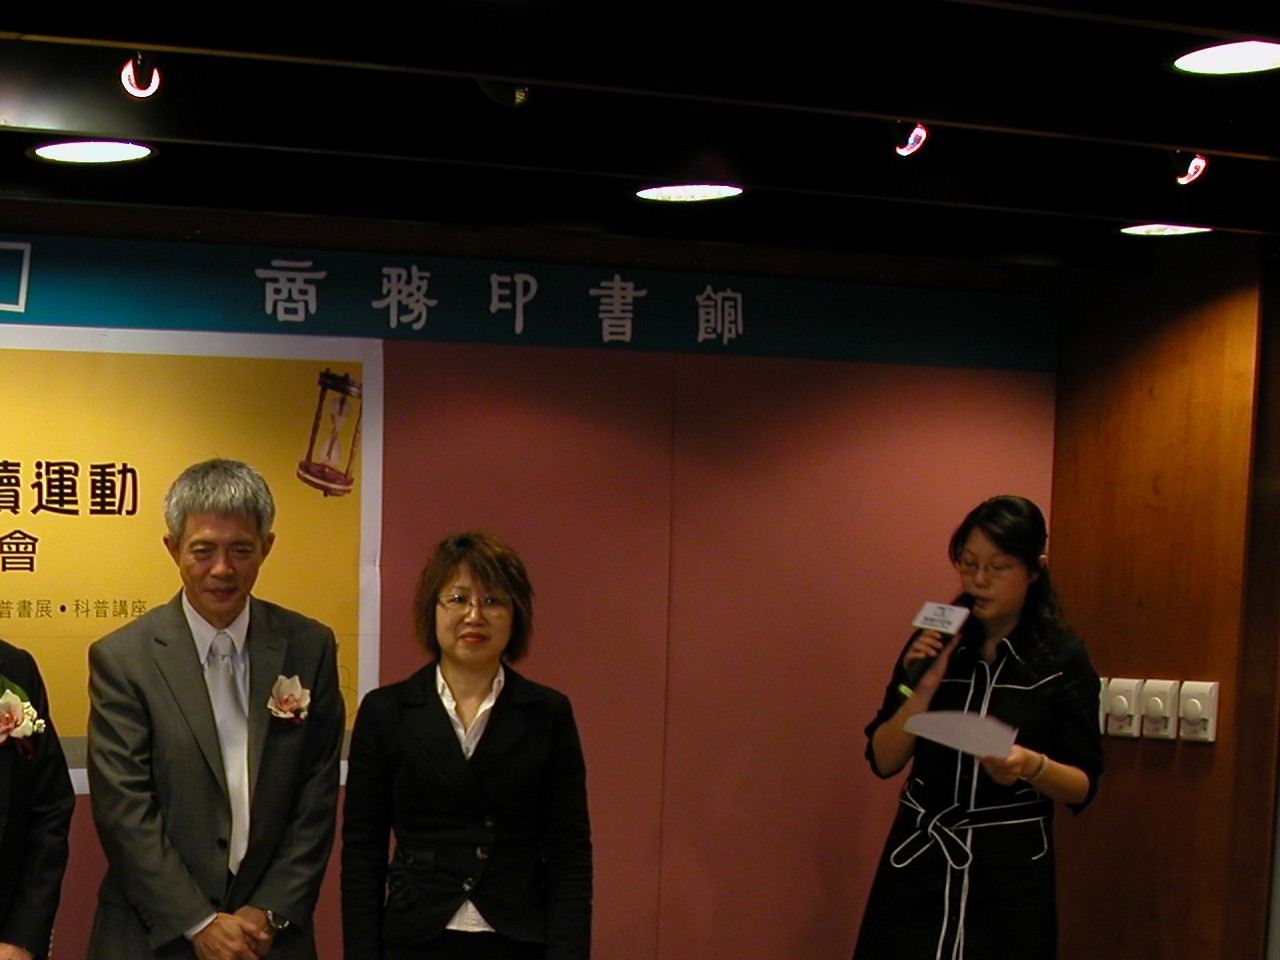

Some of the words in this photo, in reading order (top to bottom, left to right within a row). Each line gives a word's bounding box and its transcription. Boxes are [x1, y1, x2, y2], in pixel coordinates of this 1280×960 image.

[254, 258, 744, 346] 商務印書館
